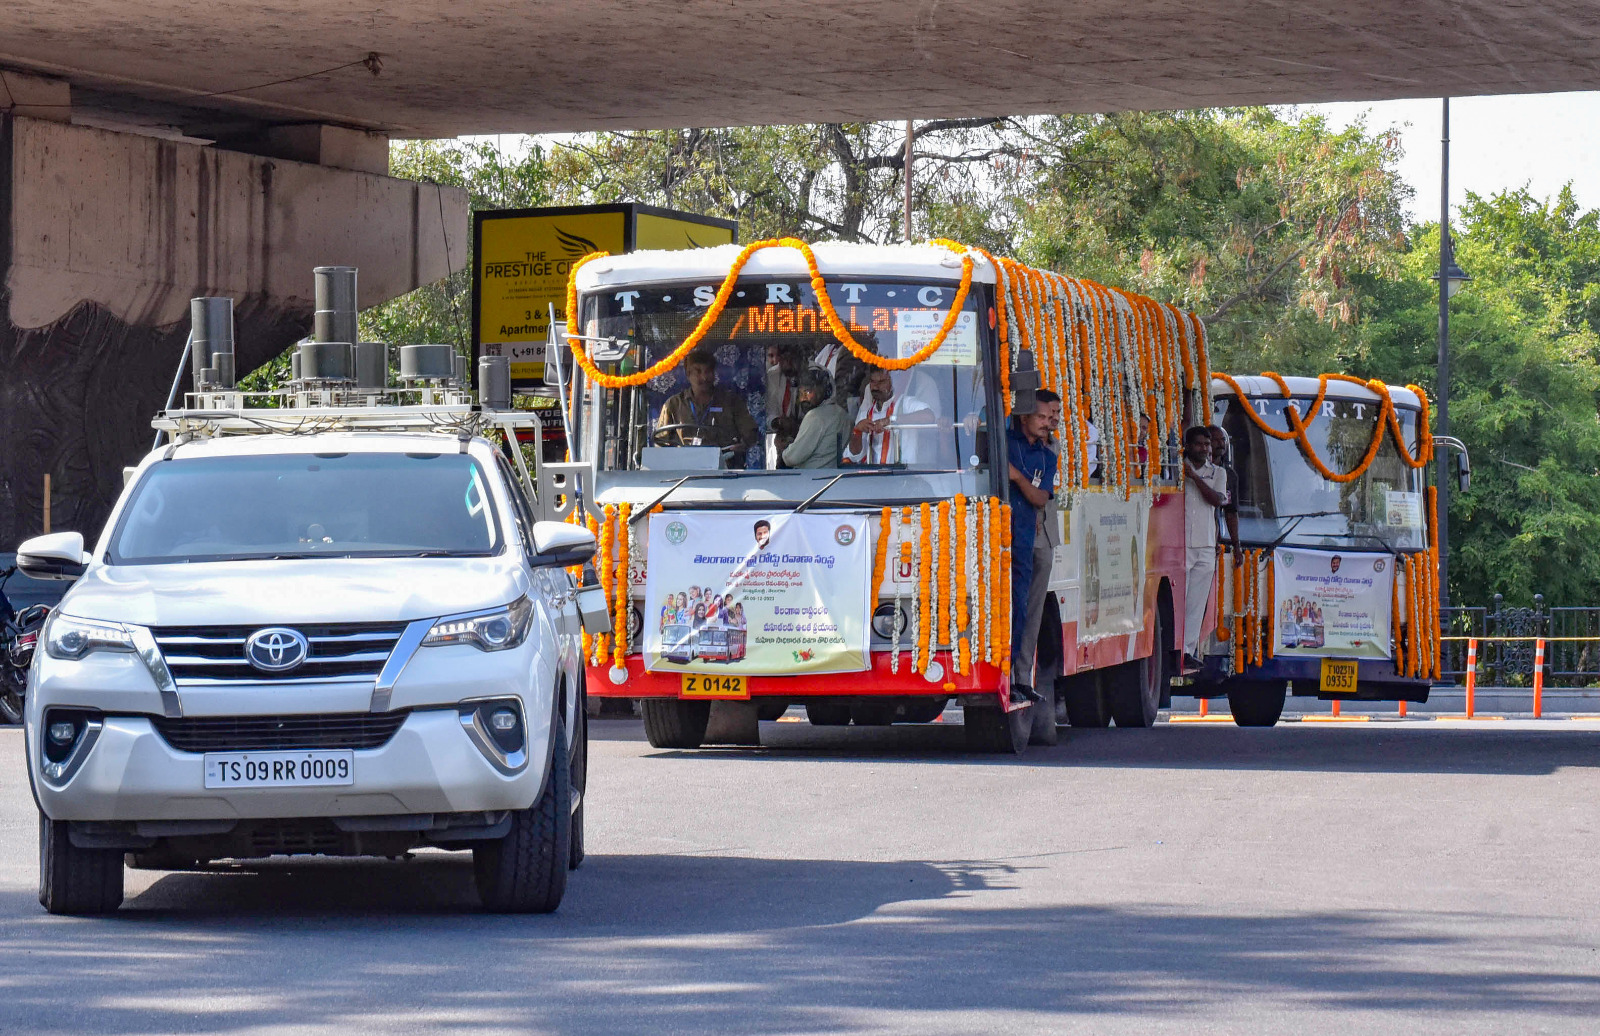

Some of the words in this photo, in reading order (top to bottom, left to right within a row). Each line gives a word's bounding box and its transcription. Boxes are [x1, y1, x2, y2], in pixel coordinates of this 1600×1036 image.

[526, 251, 546, 262] THE
[485, 261, 552, 278] PRESTIGE
[556, 261, 573, 275] CI
[525, 311, 531, 320] 3
[534, 310, 542, 319] &
[686, 678, 697, 691] Z
[703, 677, 741, 691] 0142
